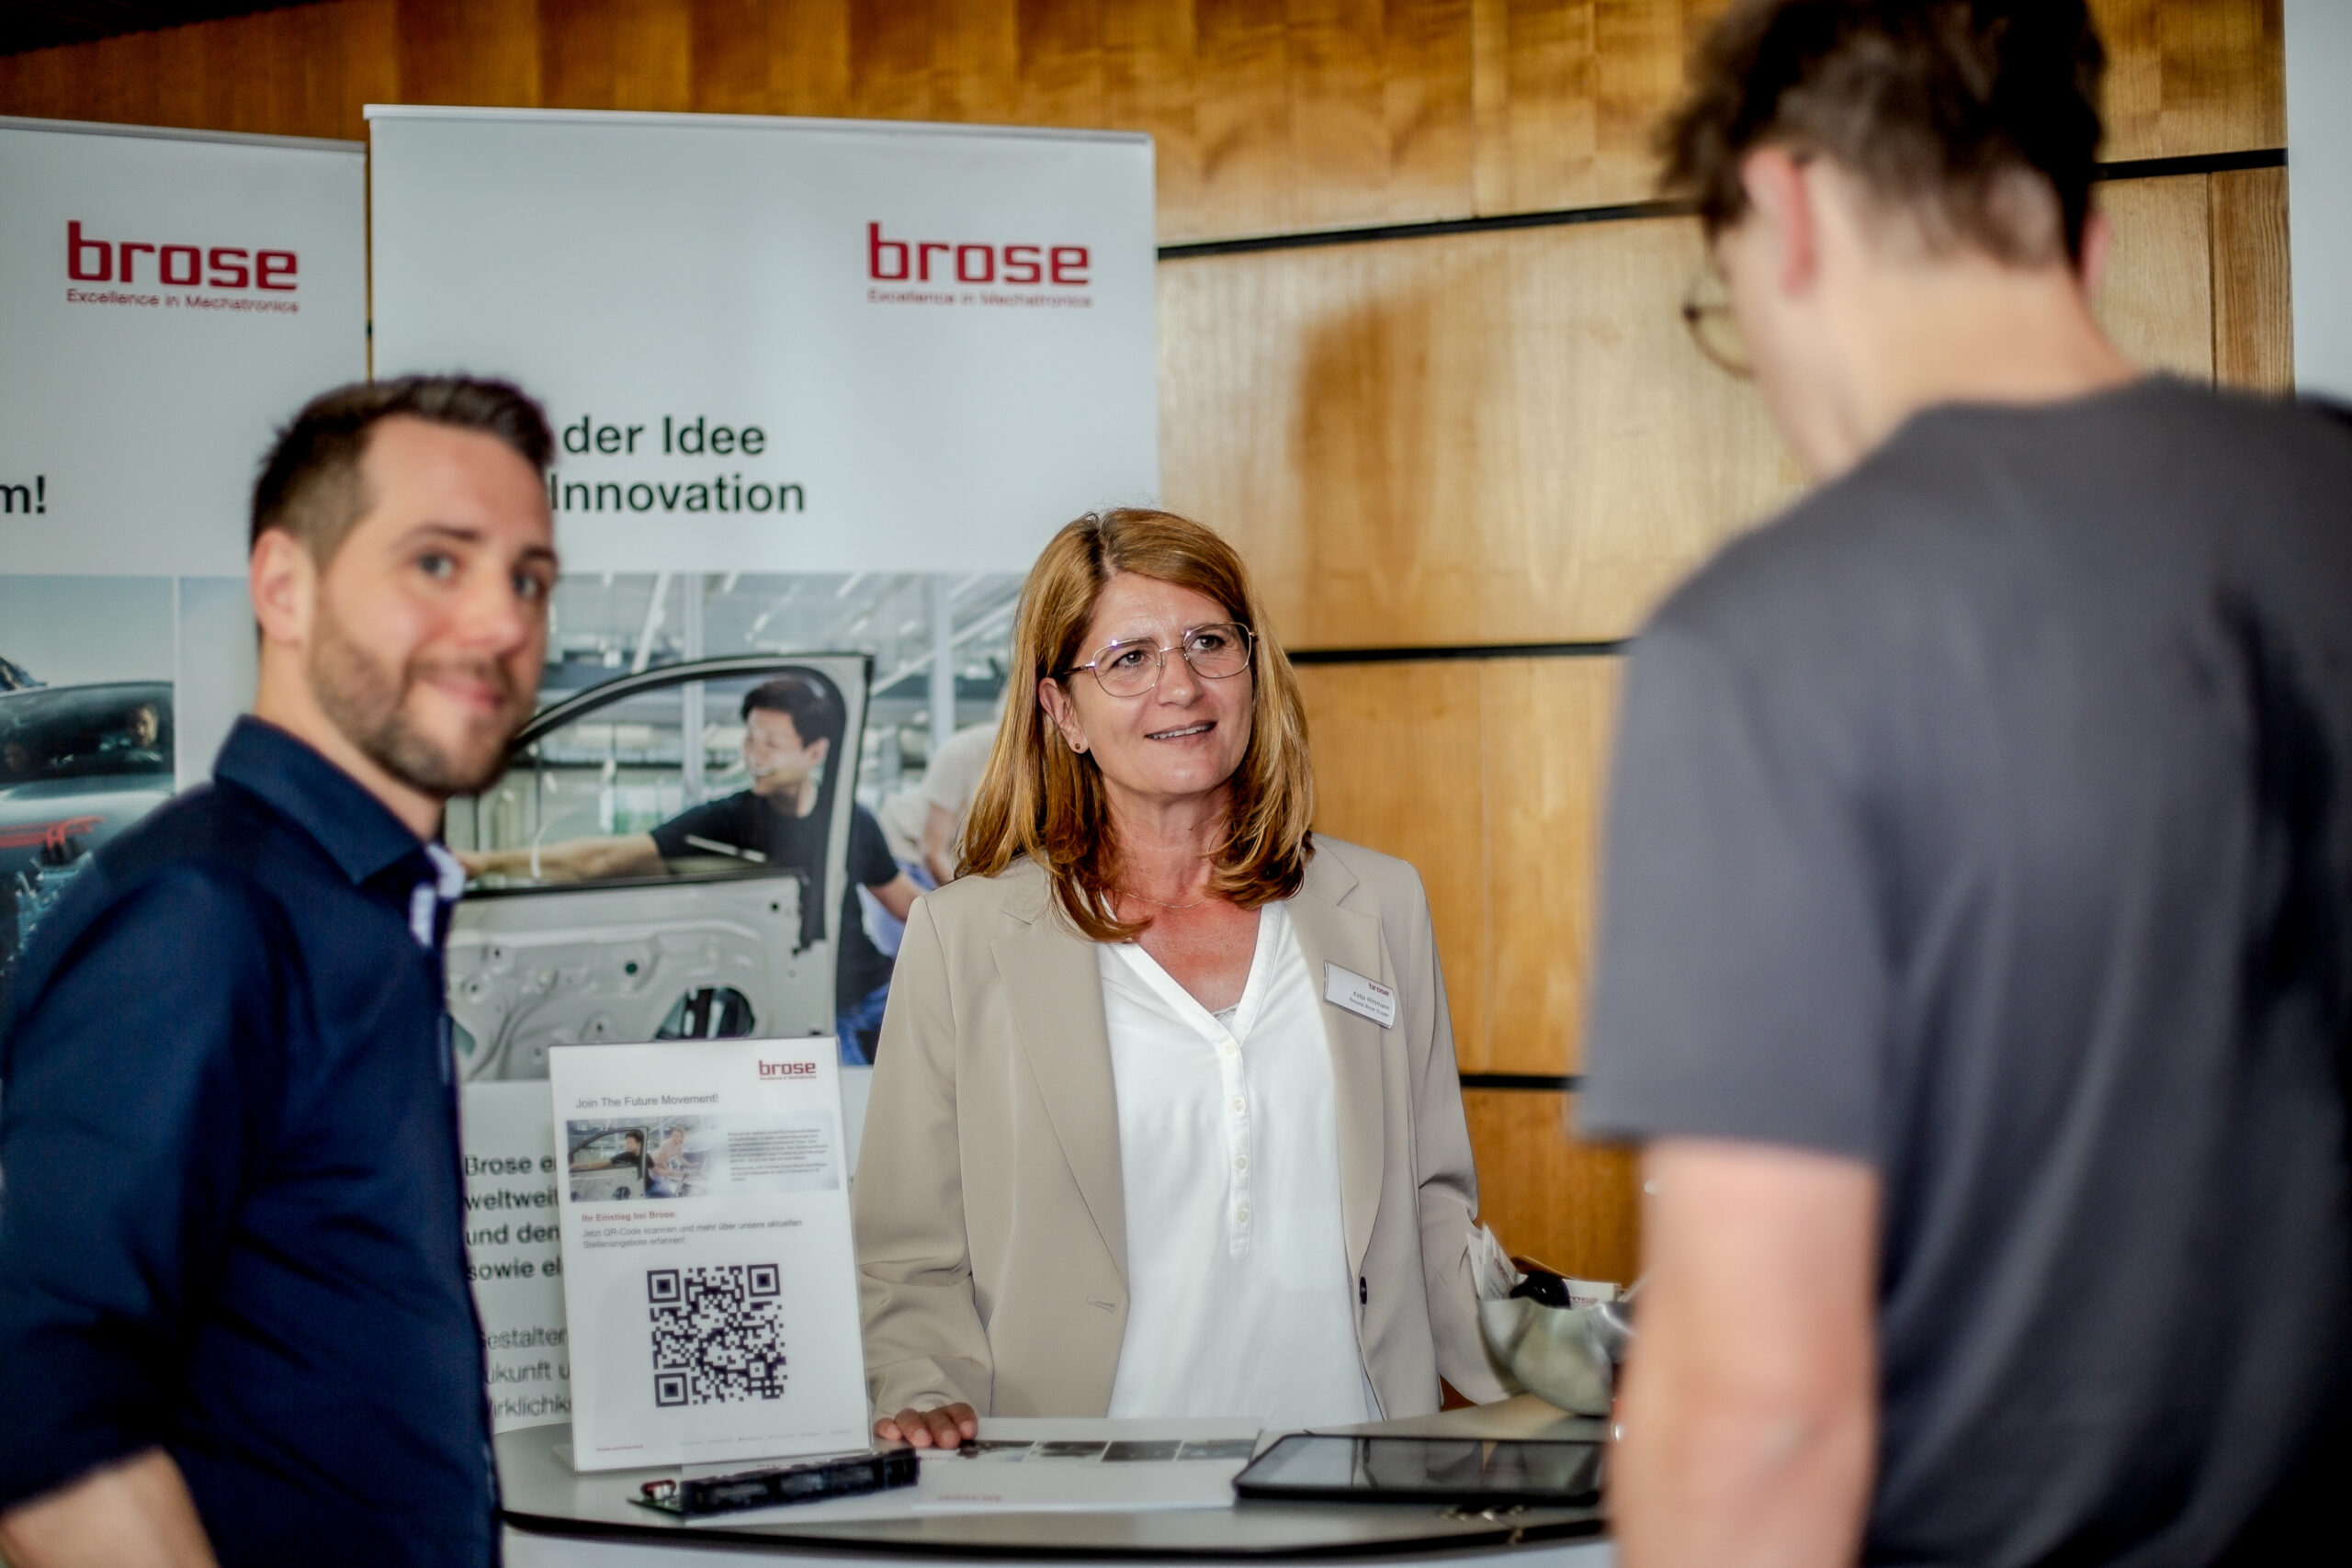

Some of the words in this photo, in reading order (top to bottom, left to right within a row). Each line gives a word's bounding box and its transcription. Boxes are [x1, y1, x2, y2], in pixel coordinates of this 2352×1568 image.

[67, 220, 298, 290] brose
[868, 221, 1089, 285] brose
[66, 288, 159, 307] Excellence
[164, 293, 180, 307] in
[186, 296, 299, 313] Mechatronics
[563, 414, 644, 454] der
[662, 415, 764, 455] Idee
[551, 472, 805, 513] Innovation
[1368, 982, 1389, 997] brose
[759, 1060, 816, 1076] brose
[576, 1099, 597, 1109] Join
[601, 1097, 621, 1107] The
[624, 1096, 658, 1106] Future
[662, 1093, 718, 1105] Movement!
[465, 1155, 532, 1176] Brose
[582, 1214, 593, 1223] Ihr
[595, 1213, 631, 1222] Einstieg
[634, 1212, 647, 1220] bei
[649, 1211, 677, 1219] Brose:
[466, 1223, 509, 1247] und
[582, 1228, 602, 1237] Jetzt
[604, 1226, 641, 1236] QR-Code
[644, 1226, 677, 1235] scannen
[680, 1224, 695, 1233] und
[696, 1224, 717, 1232] mehr
[718, 1222, 736, 1231] über
[739, 1221, 765, 1229] unsere
[767, 1219, 802, 1228] aktuellen
[583, 1239, 648, 1248] Stellenangebote
